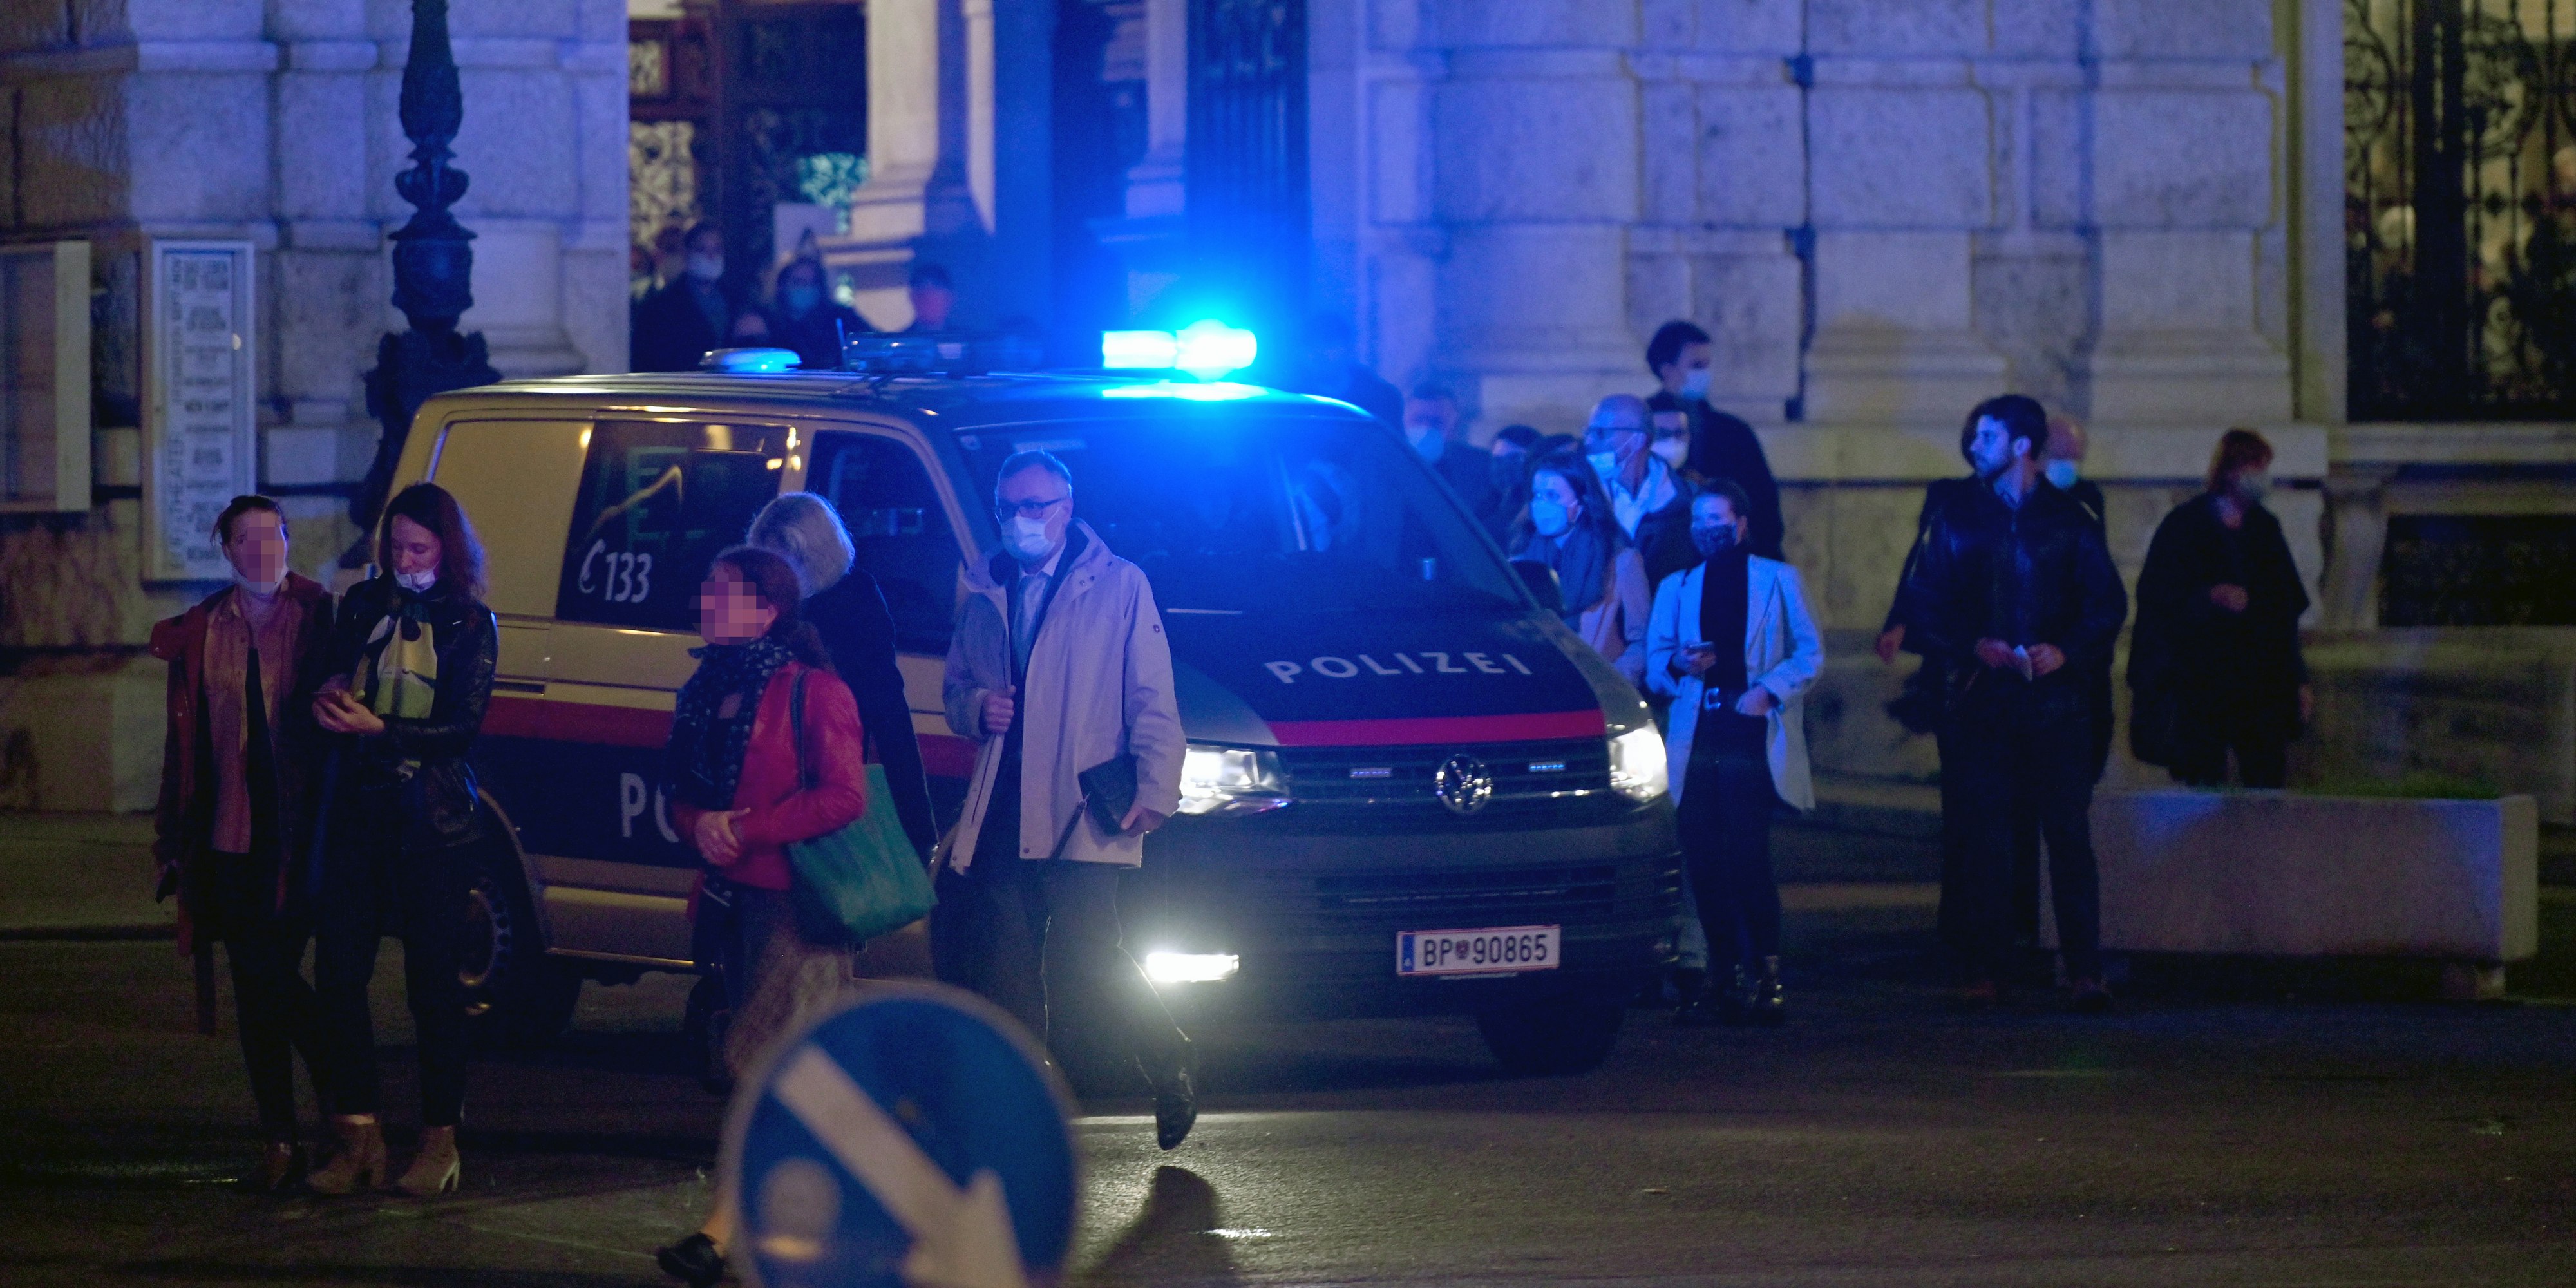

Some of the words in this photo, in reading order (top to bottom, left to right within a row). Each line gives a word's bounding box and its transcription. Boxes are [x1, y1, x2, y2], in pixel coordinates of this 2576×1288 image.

[605, 552, 653, 603] 133
[1265, 651, 1533, 684] POLIZEI
[1425, 938, 1453, 966] BP
[1473, 934, 1547, 964] 90865
